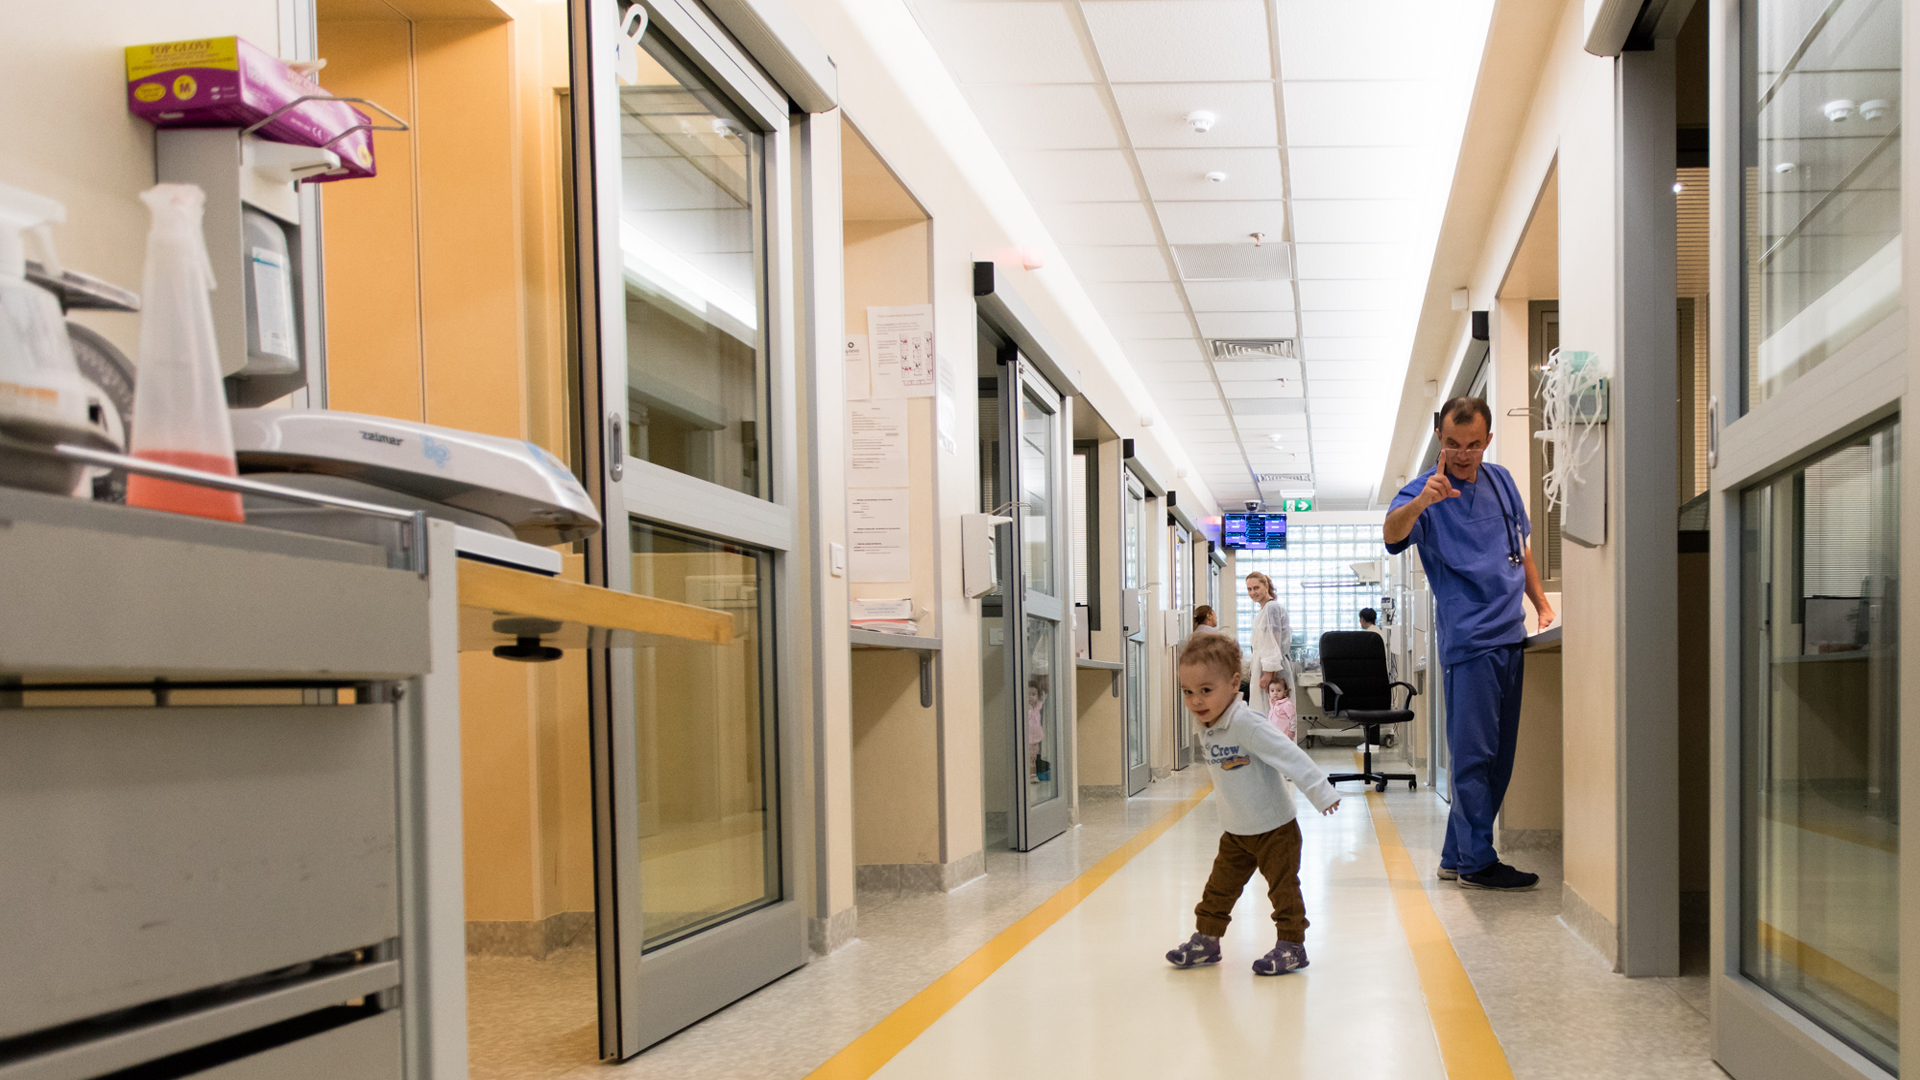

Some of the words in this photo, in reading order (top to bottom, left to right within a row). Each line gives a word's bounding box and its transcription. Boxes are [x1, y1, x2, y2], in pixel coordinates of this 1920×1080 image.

[150, 44, 171, 55] TOP
[174, 40, 213, 52] GLOVE
[179, 82, 191, 93] M
[1211, 744, 1239, 757] Crew
